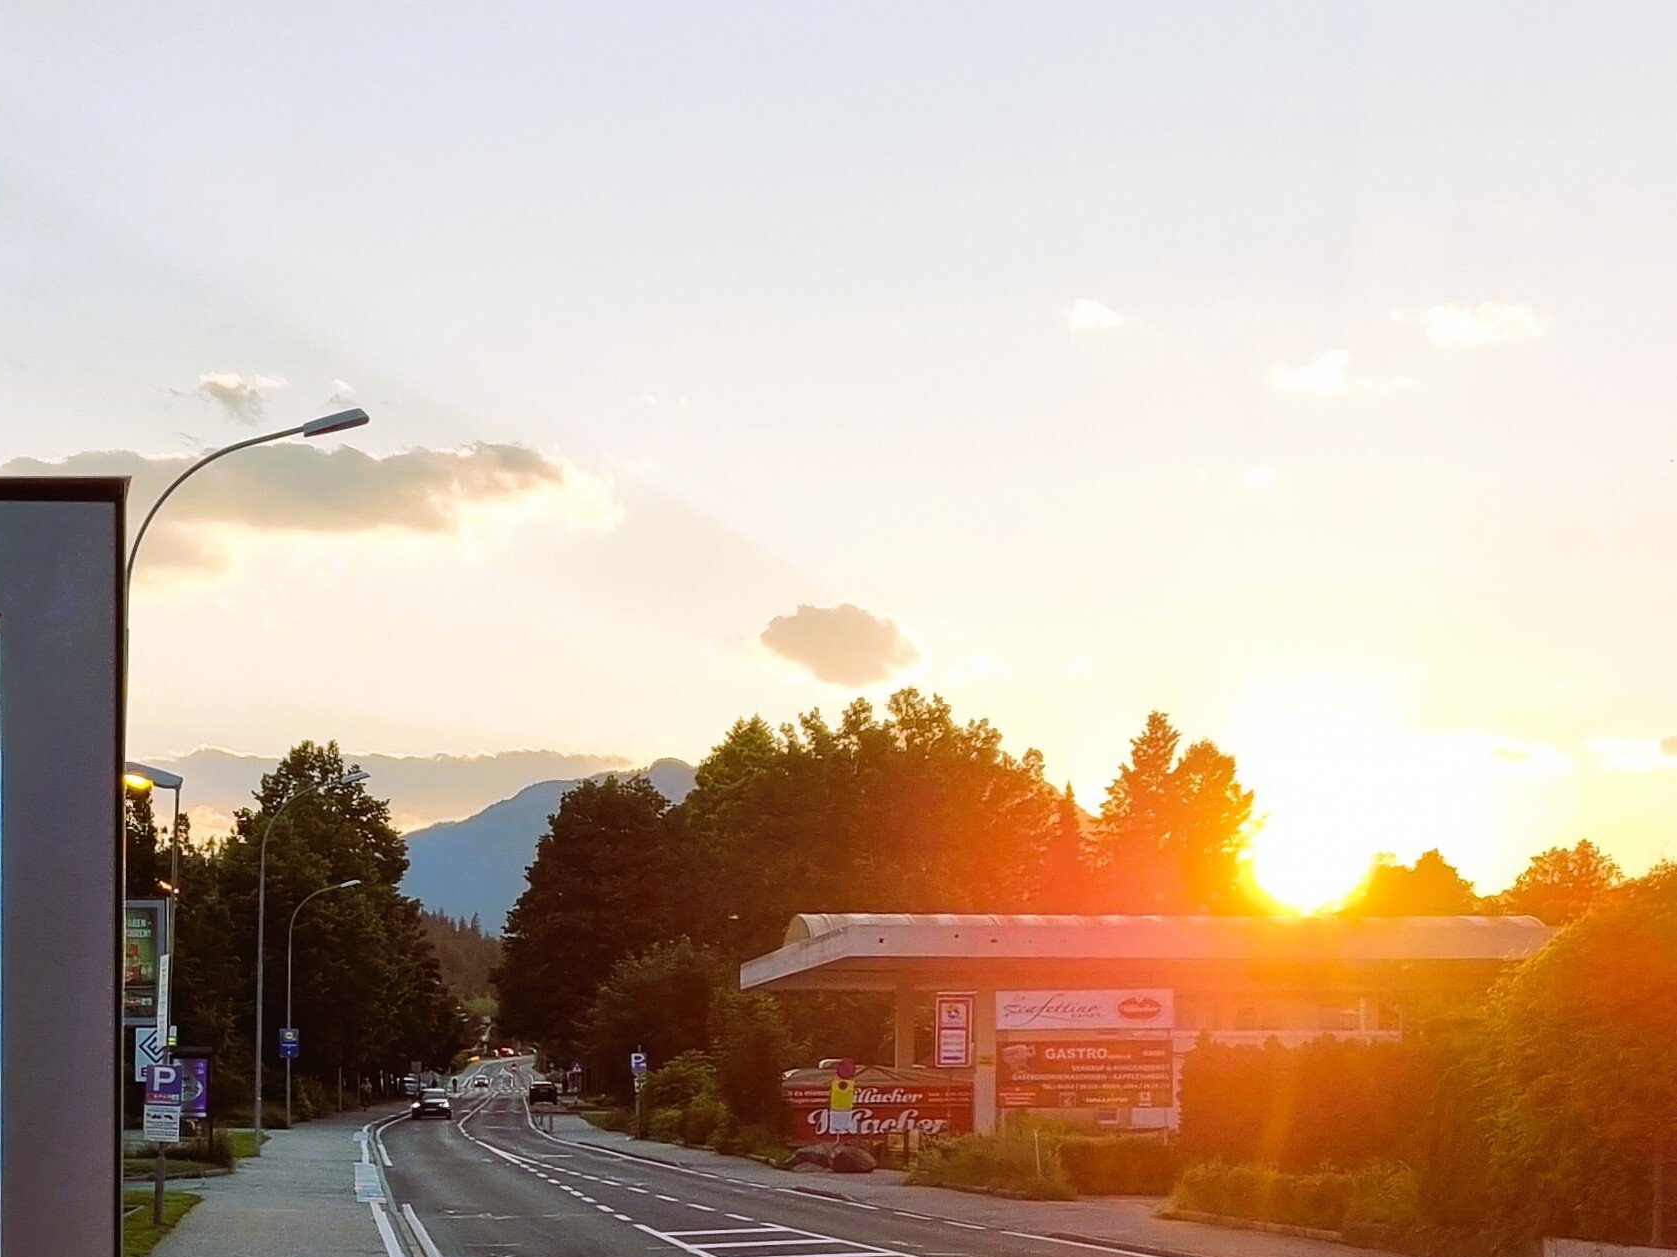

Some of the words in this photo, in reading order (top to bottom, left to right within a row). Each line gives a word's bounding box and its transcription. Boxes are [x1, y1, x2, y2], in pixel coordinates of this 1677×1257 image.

[631, 1053, 645, 1068] P
[1045, 1048, 1108, 1060] GASTRO
[153, 1066, 177, 1092] P
[853, 1088, 923, 1104] illacher
